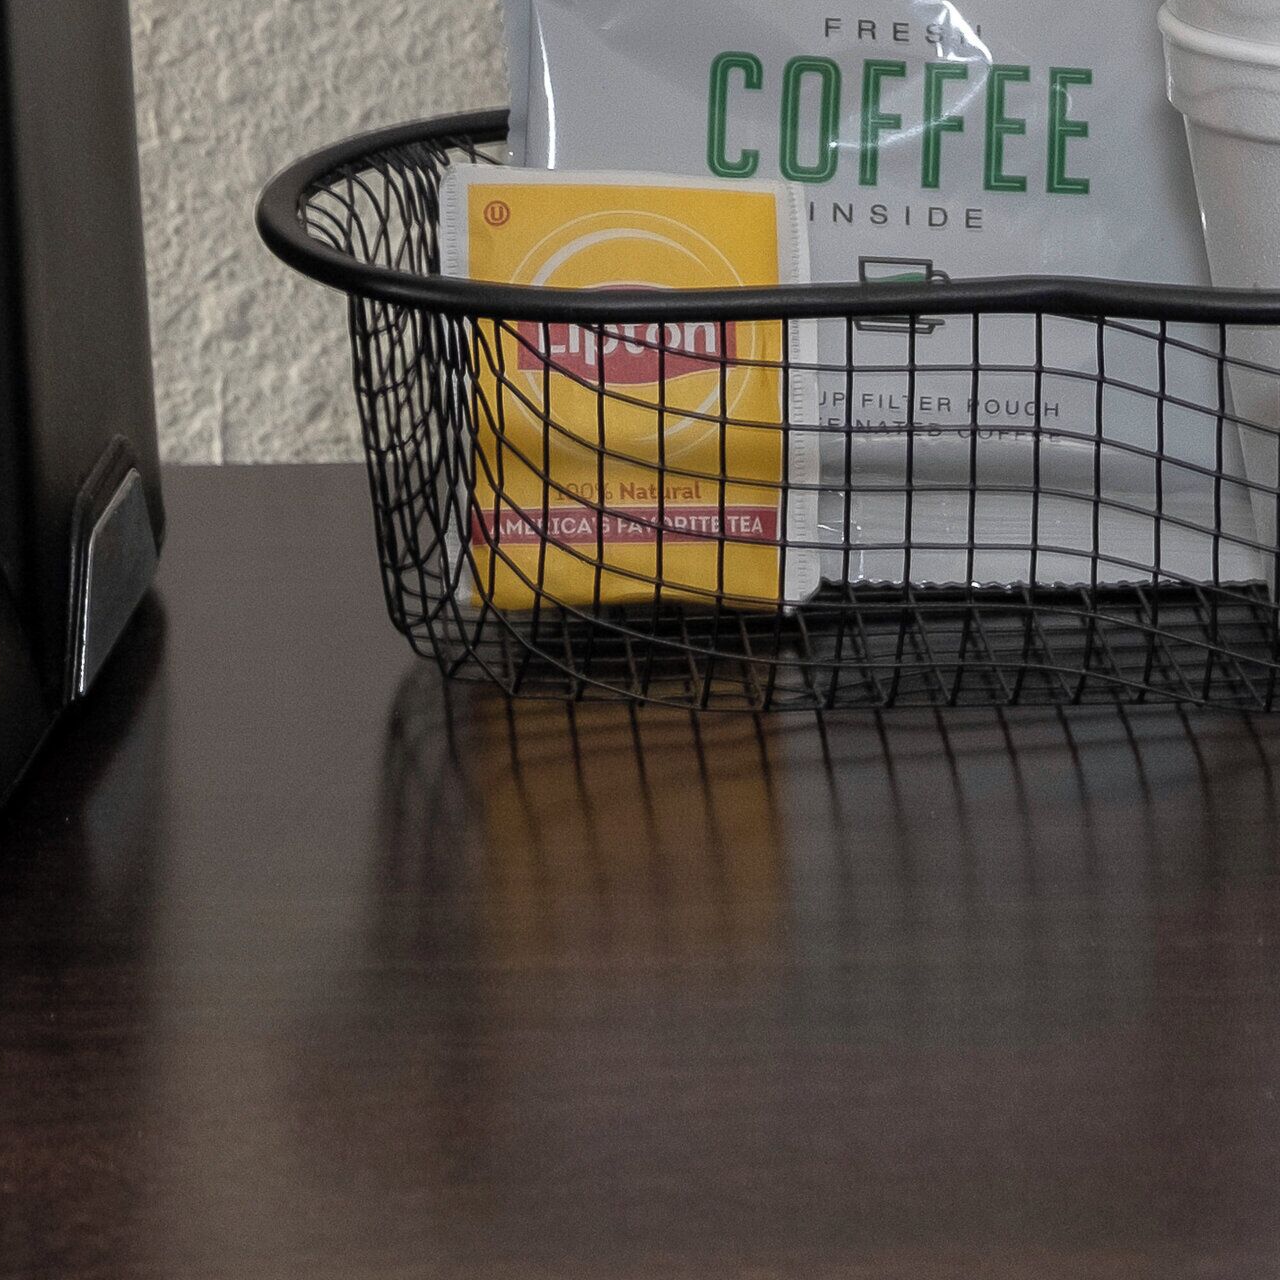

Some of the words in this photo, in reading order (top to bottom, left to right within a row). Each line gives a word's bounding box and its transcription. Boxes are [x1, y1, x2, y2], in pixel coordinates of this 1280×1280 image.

[707, 50, 1093, 195] COFFEE
[809, 200, 984, 230] INSIDE
[620, 480, 702, 500] Natural
[489, 517, 610, 536] AMEICA'S
[617, 515, 722, 534] FARITE
[726, 516, 764, 534] TEA
